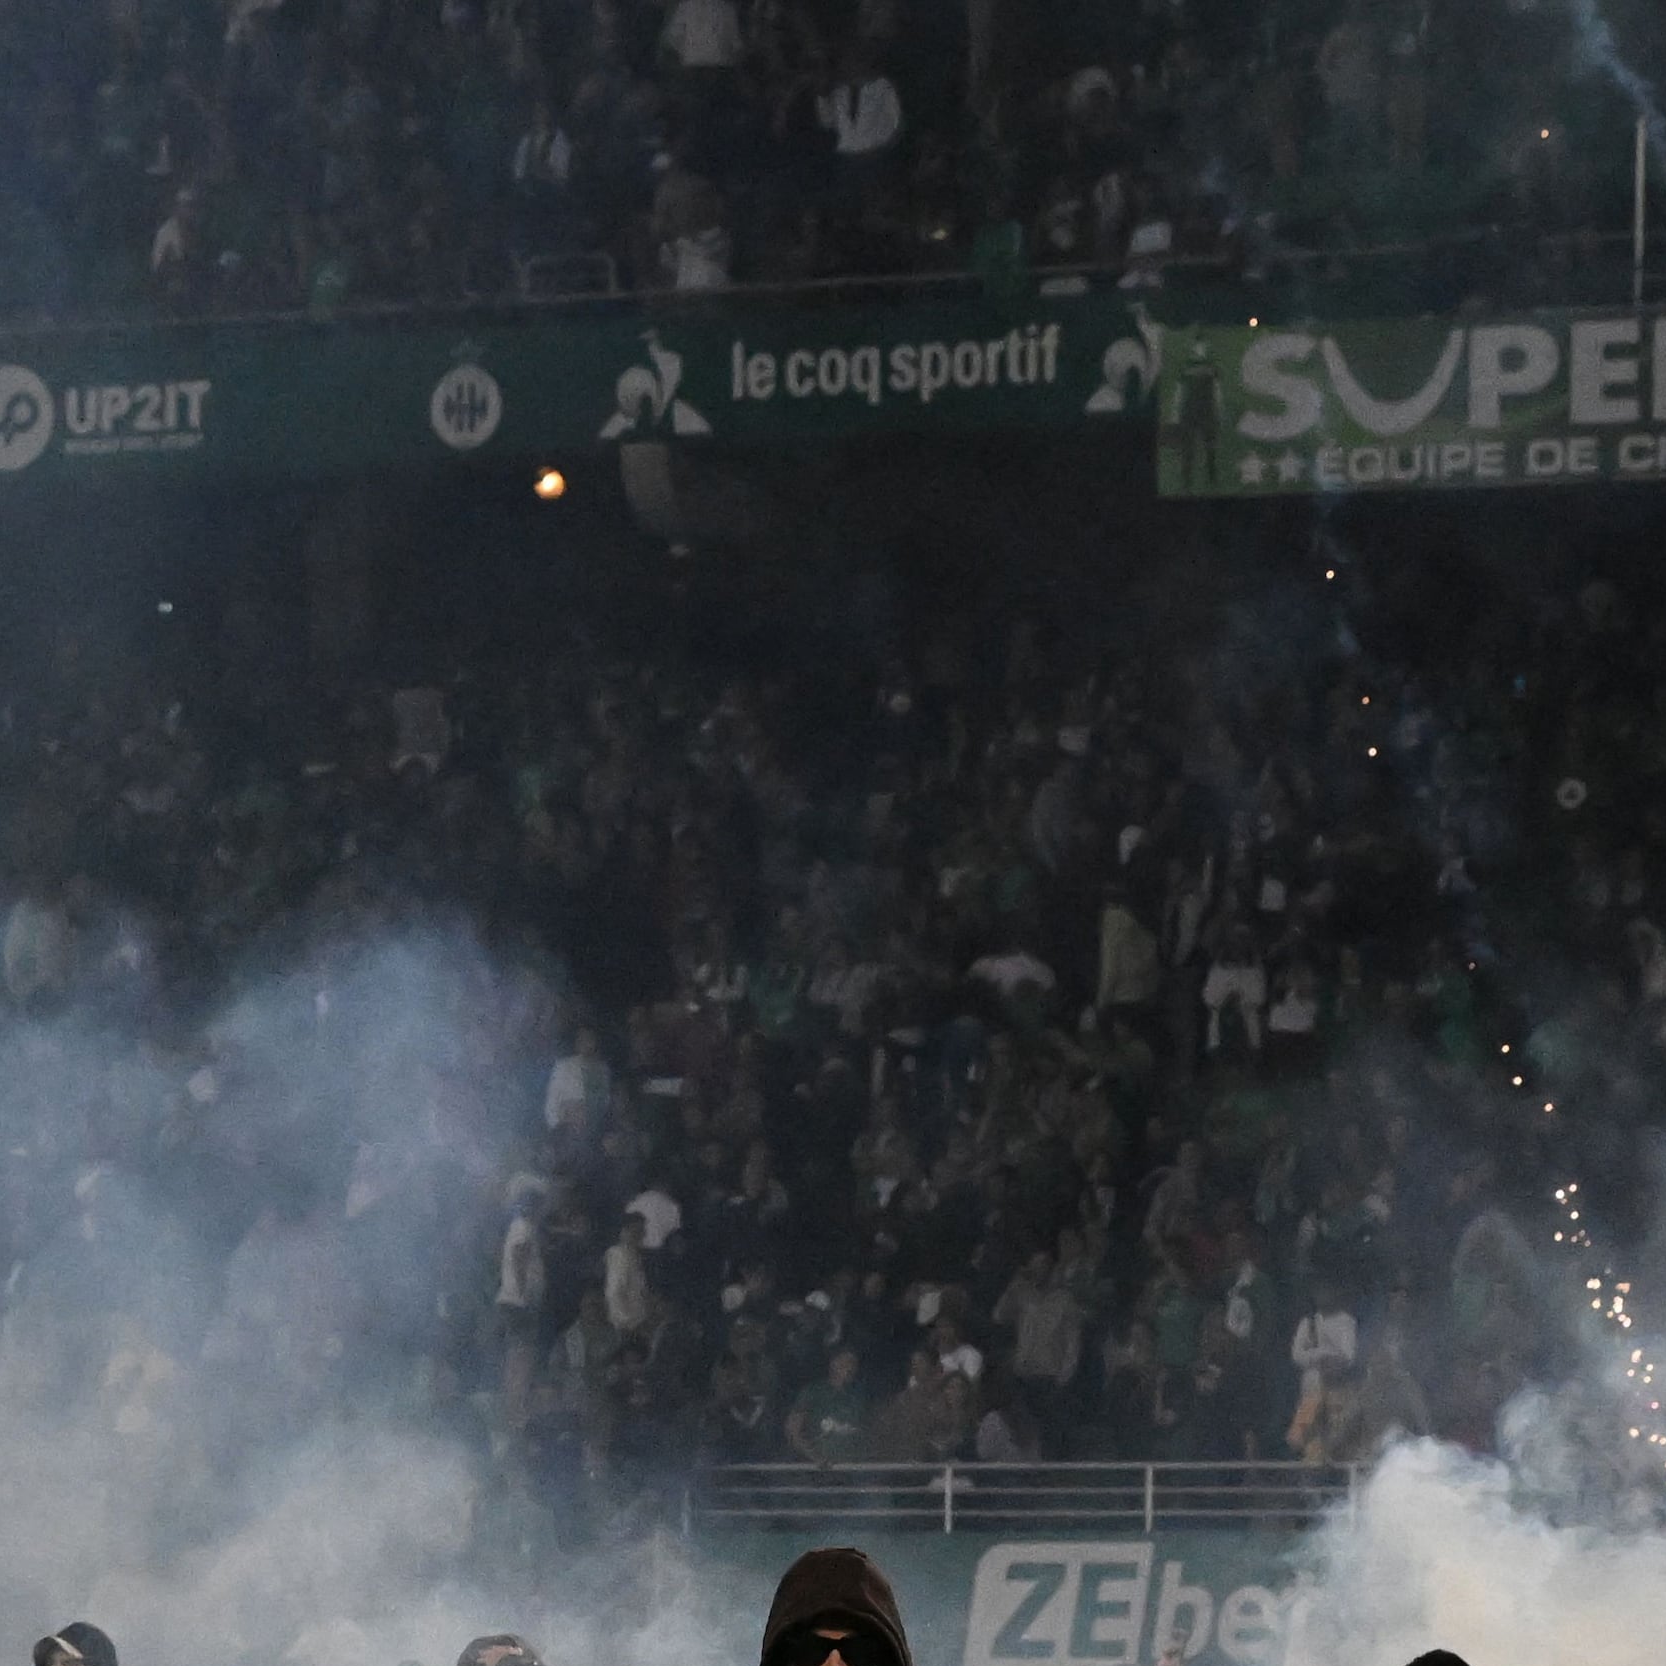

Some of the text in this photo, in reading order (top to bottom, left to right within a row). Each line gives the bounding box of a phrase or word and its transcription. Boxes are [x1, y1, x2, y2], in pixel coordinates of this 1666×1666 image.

[733, 323, 1061, 403] le coq sportif
[65, 379, 212, 436] UP2IT
[1524, 432, 1600, 474] DE
